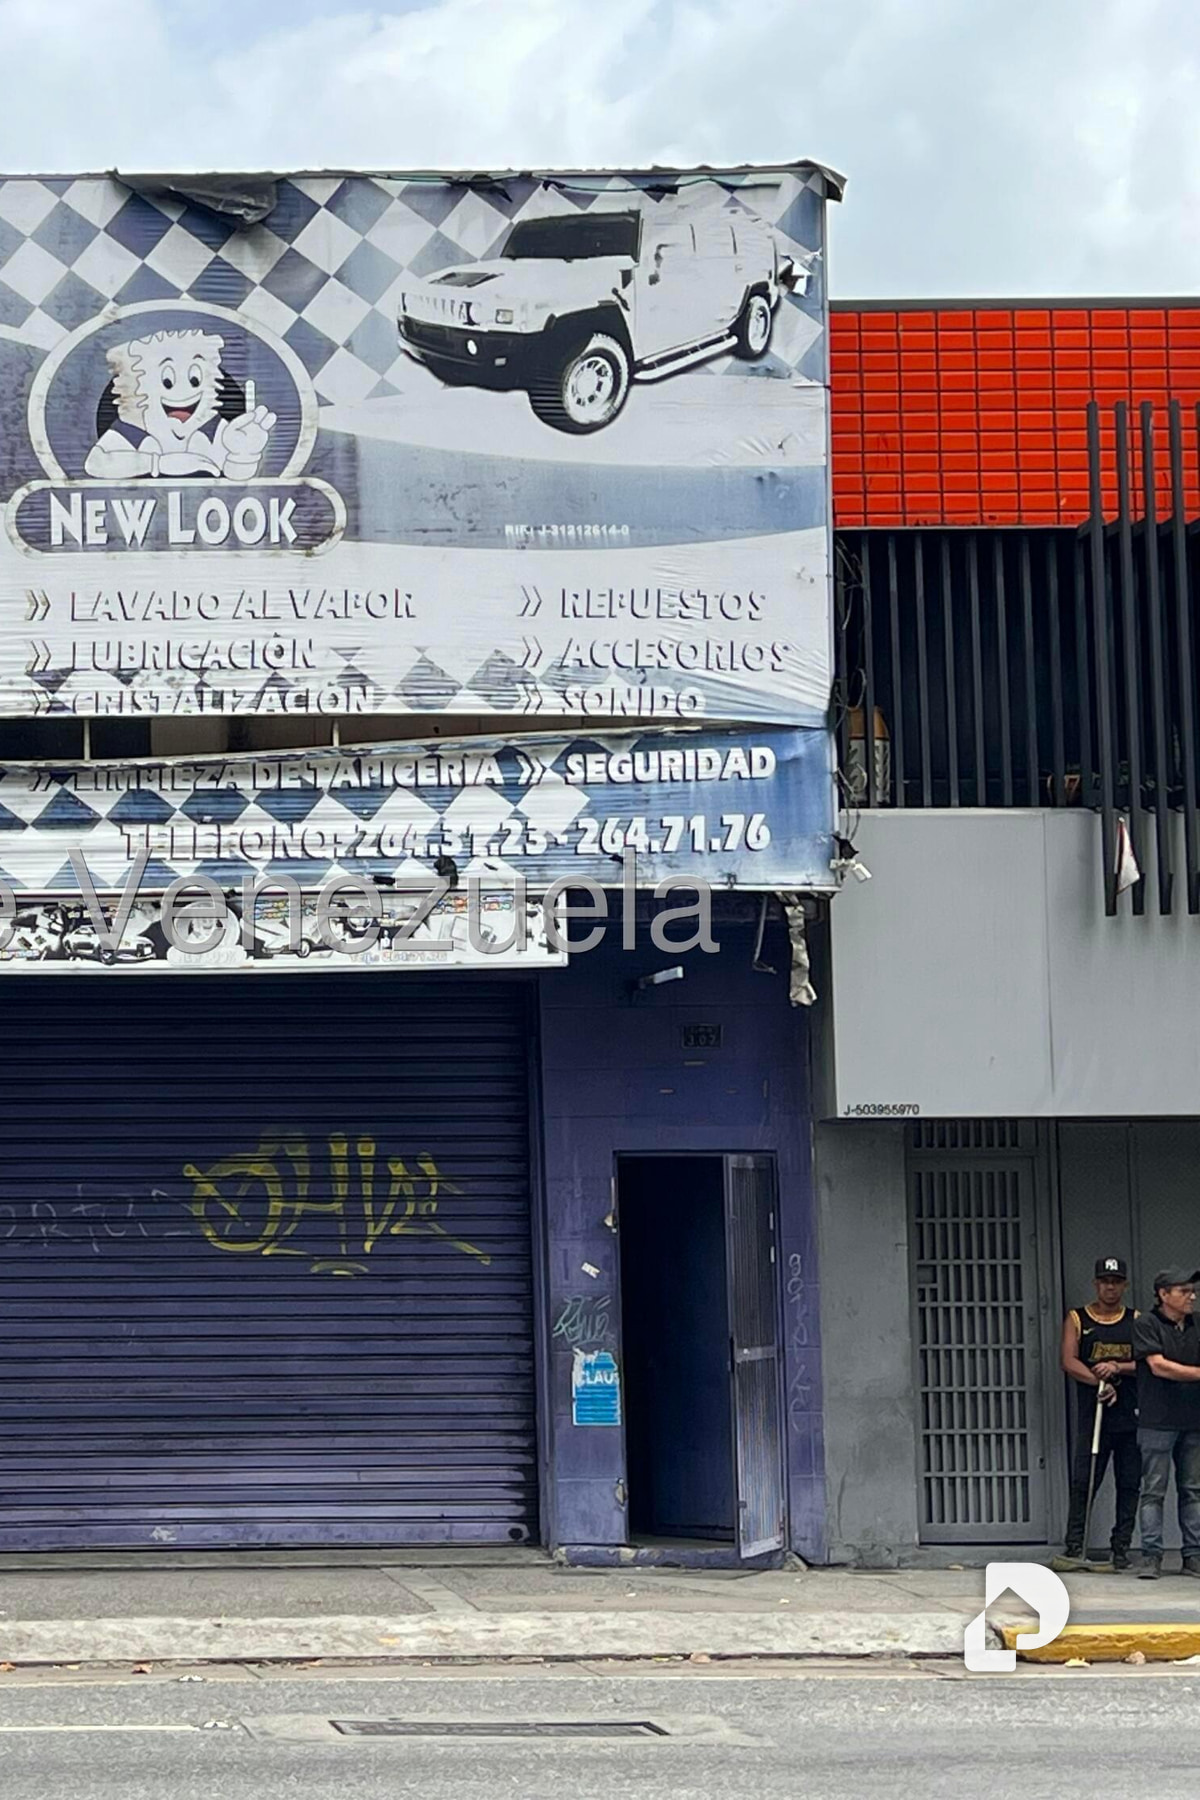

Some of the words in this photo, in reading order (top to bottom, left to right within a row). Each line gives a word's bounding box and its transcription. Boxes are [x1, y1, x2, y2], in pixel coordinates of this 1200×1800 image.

[50, 492, 157, 547] NEW
[168, 491, 298, 545] LOOK
[71, 590, 220, 622] LAVADO
[231, 589, 282, 619] AL
[288, 588, 418, 619] VAPOR
[561, 587, 769, 621] REPUESTOS
[71, 633, 317, 671] LUBRICACIÓN
[558, 638, 792, 673] ACCESORIOS
[559, 688, 707, 716] SONIDO
[253, 759, 309, 790] DE
[563, 746, 779, 785] SEGURIDAD
[350, 817, 550, 857] 264.31.23
[576, 813, 773, 855] 264.71.76
[843, 1103, 920, 1116] J-503955970
